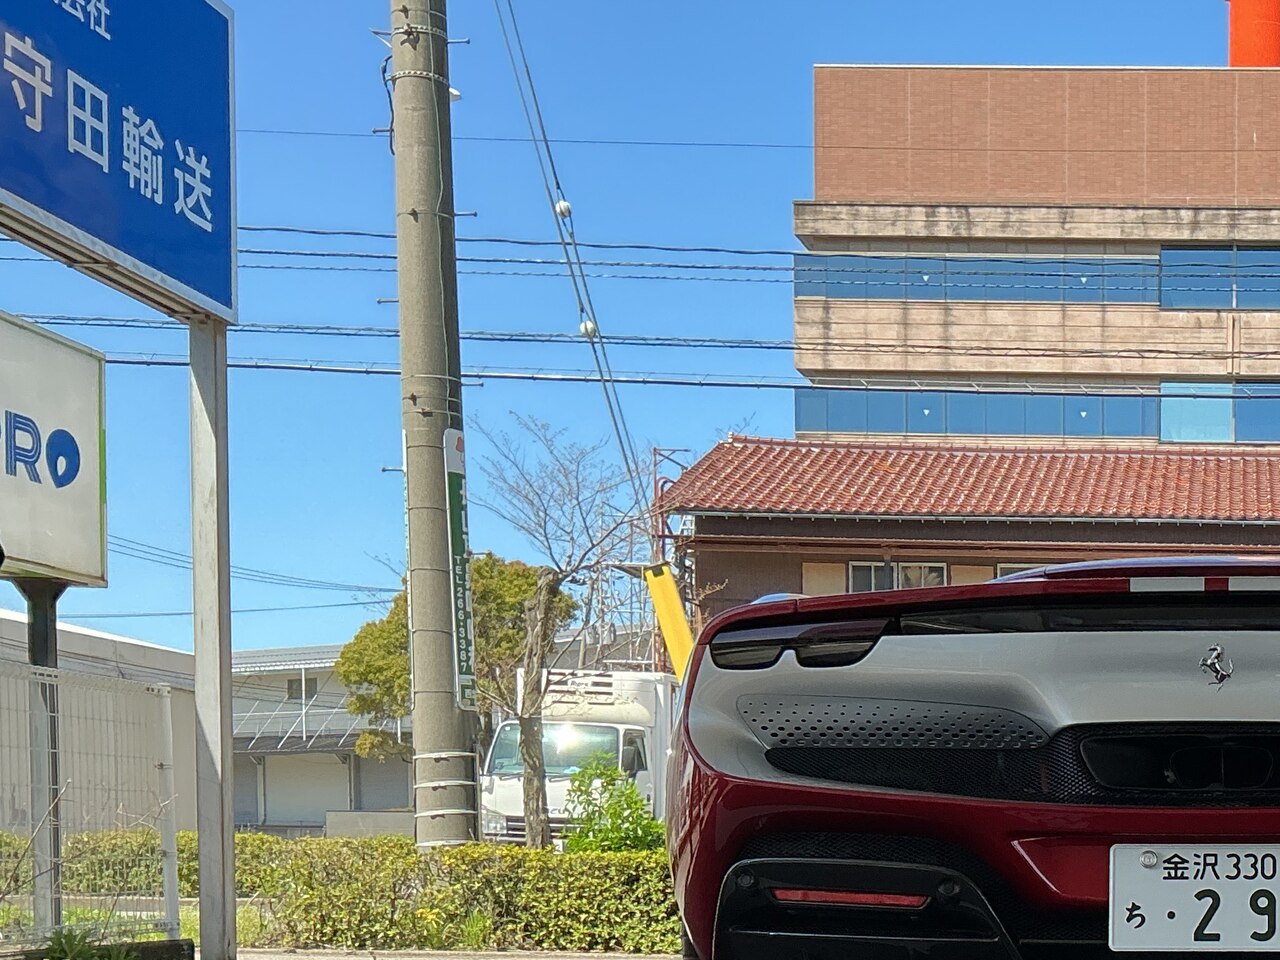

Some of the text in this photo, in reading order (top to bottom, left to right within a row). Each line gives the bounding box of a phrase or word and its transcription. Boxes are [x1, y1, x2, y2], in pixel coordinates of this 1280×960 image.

[3, 31, 213, 232] 守田輸送
[1162, 853, 1277, 880] 金沢330
